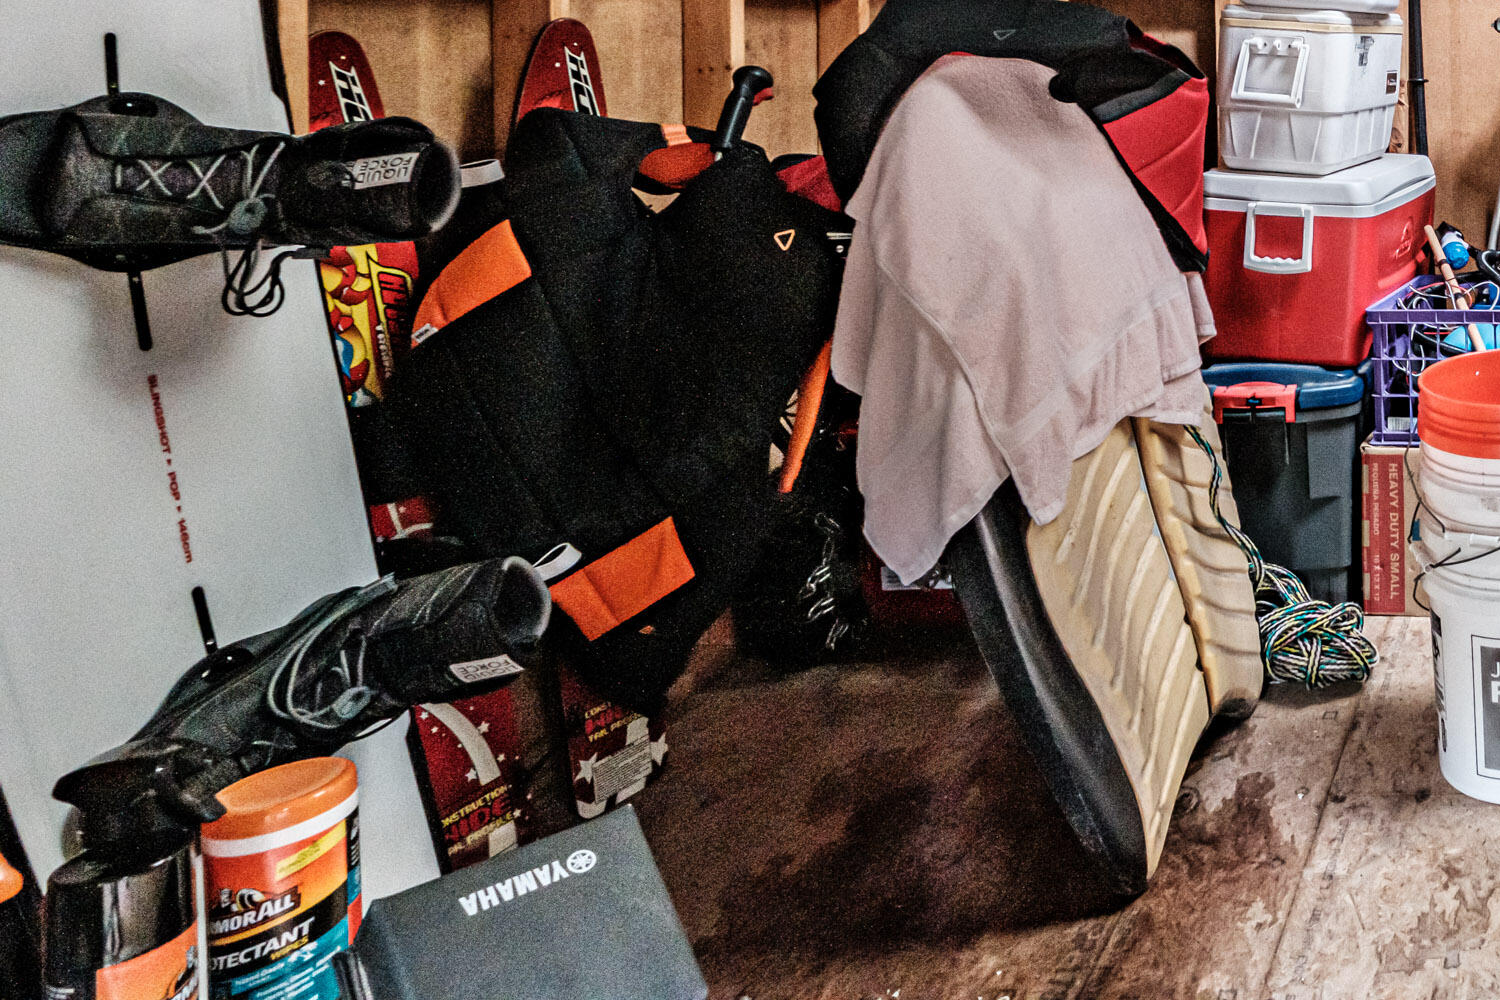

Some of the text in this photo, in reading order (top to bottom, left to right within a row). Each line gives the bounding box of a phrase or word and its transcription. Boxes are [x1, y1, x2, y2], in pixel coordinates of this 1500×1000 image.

[355, 166, 409, 183] LIQUID
[359, 156, 413, 171] FORCE
[147, 374, 171, 454] SLINGSHOT
[167, 471, 181, 501] POP
[1388, 463, 1400, 600] HEAVY DUTY SMALL
[458, 659, 511, 675] FORCE
[458, 860, 570, 916] YAMAHA
[211, 894, 295, 934] MORALL
